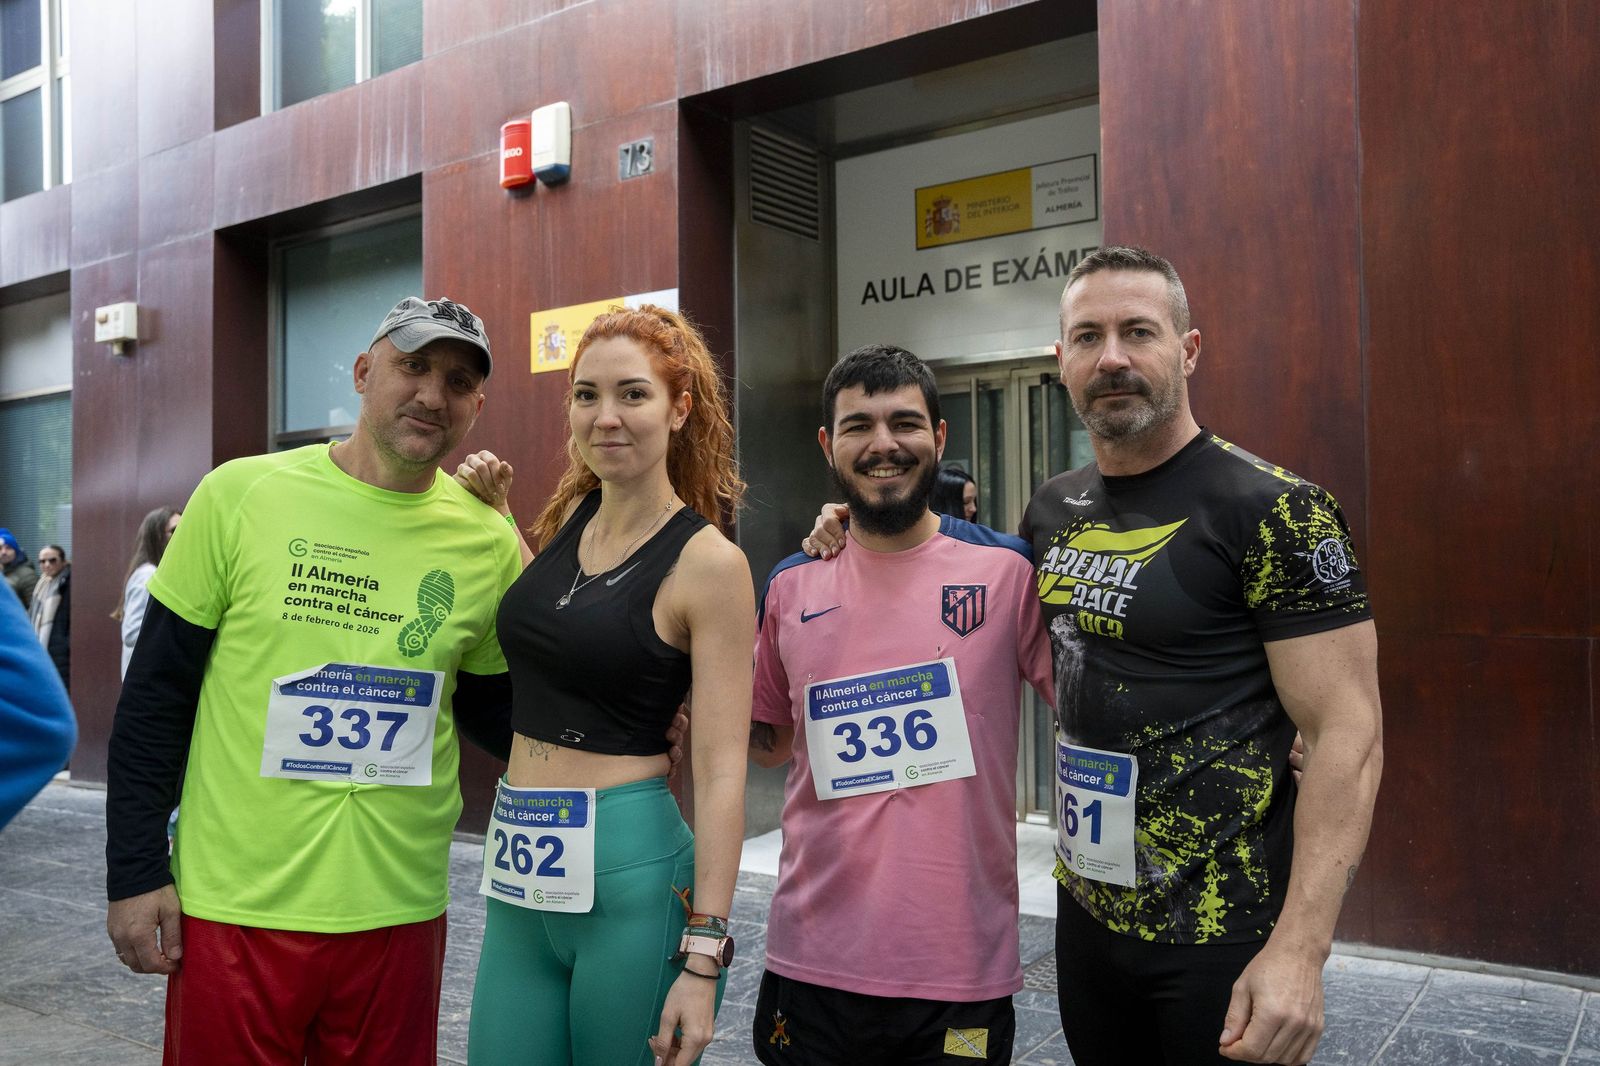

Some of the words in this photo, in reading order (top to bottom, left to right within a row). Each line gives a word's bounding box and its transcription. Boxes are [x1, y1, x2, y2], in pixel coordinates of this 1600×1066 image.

[966, 195, 1011, 210] MINISTERIO
[1045, 200, 1082, 214] ALMERÍA
[861, 272, 935, 306] AULA
[944, 264, 982, 293] DE
[291, 563, 303, 577] II
[306, 565, 380, 591] Almería
[1040, 546, 1143, 590] ARENAL
[1320, 558, 1346, 579] SUR
[288, 582, 306, 592] en
[311, 584, 367, 603] marcha
[1070, 583, 1133, 618] RACE
[284, 596, 333, 611] contra
[336, 602, 350, 615] el
[354, 606, 404, 623] cáncer
[282, 612, 288, 620] 8
[291, 613, 302, 622] de
[305, 614, 340, 628] febrero
[343, 621, 354, 631] de
[356, 624, 380, 635] 2026
[297, 682, 339, 694] contra
[342, 684, 355, 695] el
[358, 685, 402, 699] cáncer
[356, 672, 371, 682] en
[374, 674, 420, 687] marcha
[816, 690, 822, 700] II
[823, 683, 868, 699] Almería
[869, 681, 884, 691] en
[888, 670, 934, 687] marcha
[821, 699, 859, 713] contra
[862, 695, 873, 706] el
[876, 688, 917, 703] cáncer
[299, 705, 409, 752] 337
[833, 709, 937, 763] 336
[1067, 756, 1076, 765] en
[1078, 758, 1118, 772] marcha
[1063, 768, 1068, 778] el
[1069, 770, 1101, 785] cáncer
[514, 798, 524, 806] en
[528, 797, 573, 807] marcha
[508, 809, 516, 819] el
[518, 810, 554, 822] cáncer
[494, 828, 565, 877] 262
